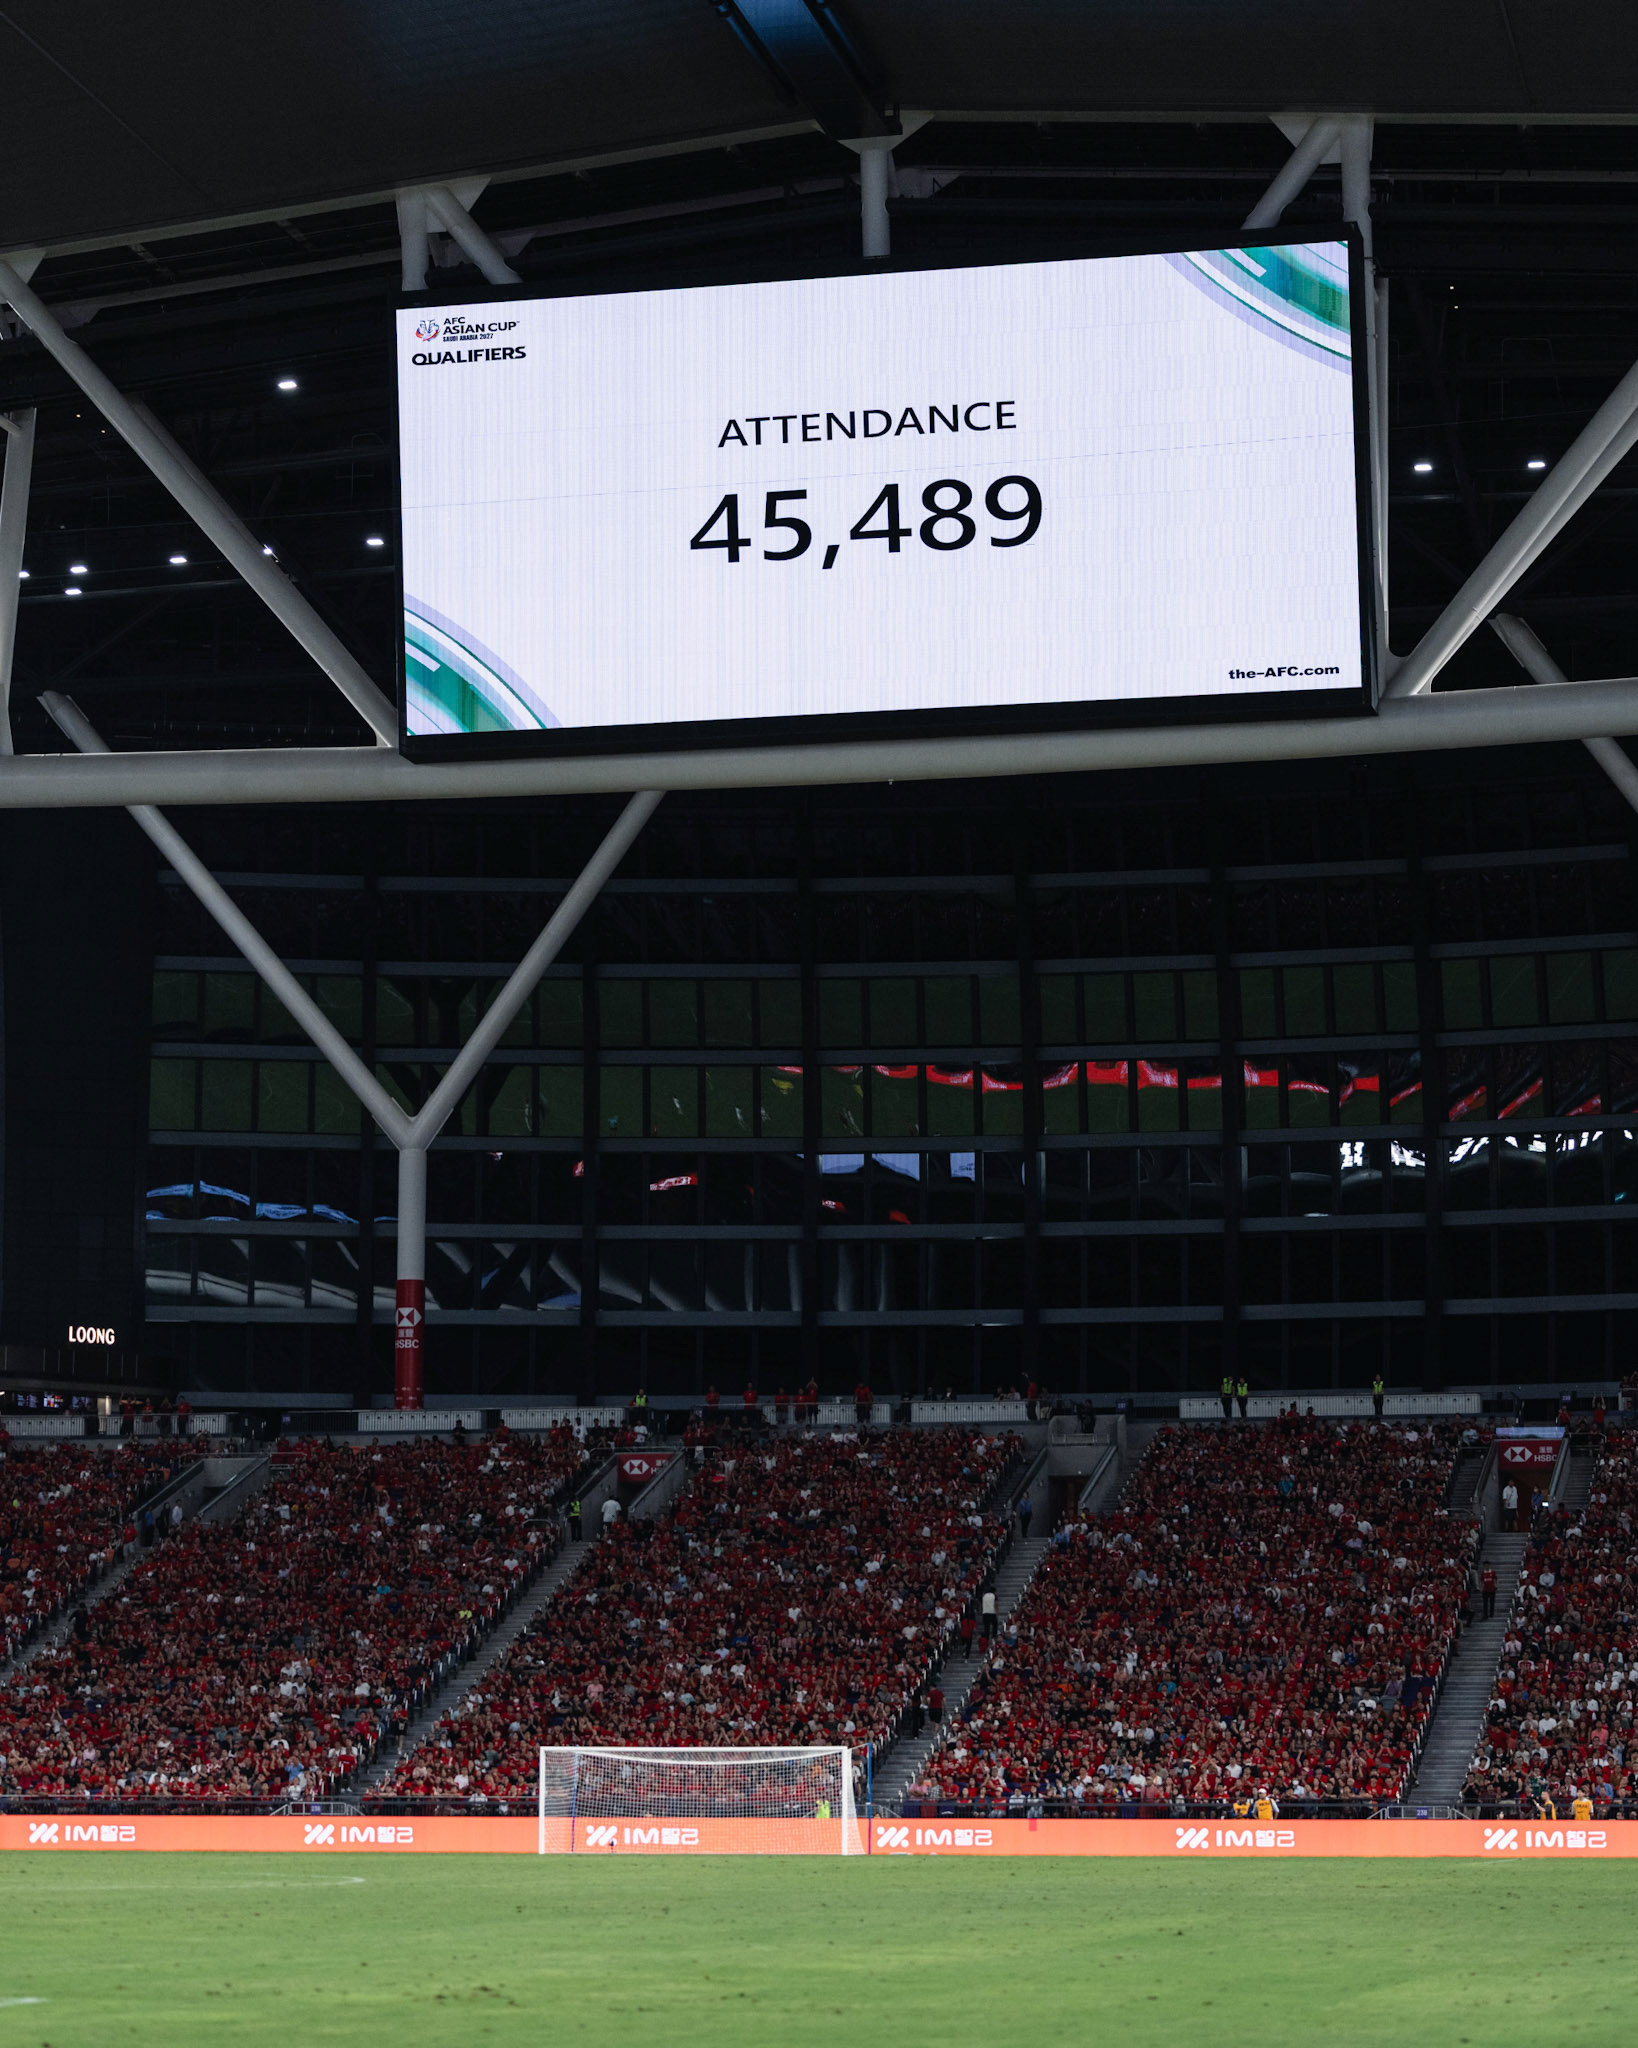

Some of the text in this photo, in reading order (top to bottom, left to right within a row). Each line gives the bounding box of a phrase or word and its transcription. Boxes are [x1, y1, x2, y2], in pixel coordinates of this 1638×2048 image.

[442, 323, 485, 335] ASIAN
[443, 316, 466, 325] AFC
[411, 346, 527, 366] QUALIFIERS
[718, 400, 1017, 448] ATTENDANCE
[690, 475, 1043, 570] 45,489
[1228, 666, 1340, 680] the-AFC.com
[68, 1325, 115, 1345] LOONG
